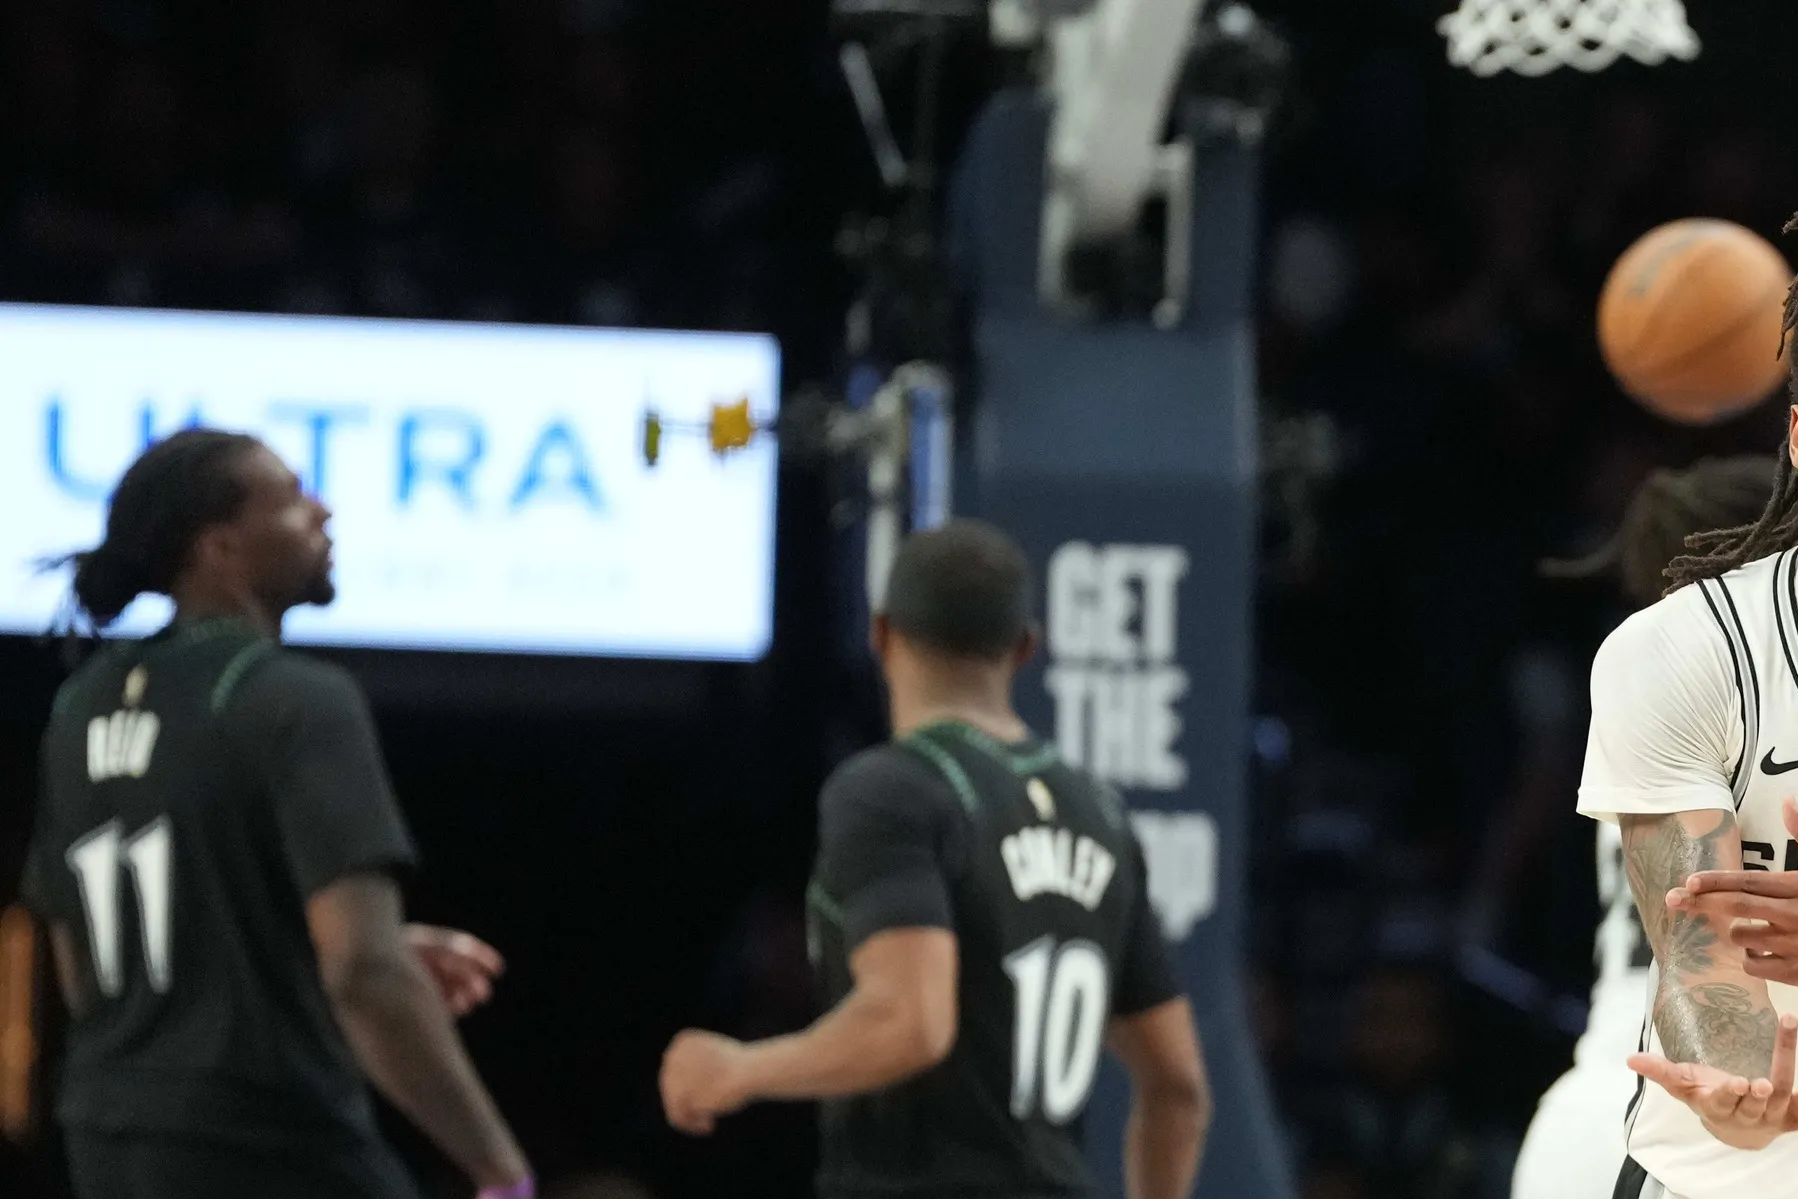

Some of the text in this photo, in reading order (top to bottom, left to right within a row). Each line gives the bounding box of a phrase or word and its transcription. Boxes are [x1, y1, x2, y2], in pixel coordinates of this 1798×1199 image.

[42, 394, 608, 520] UTRA
[1047, 541, 1188, 658] GET
[1044, 663, 1189, 790] THE
[66, 816, 175, 997] 11
[1001, 934, 1107, 1125] 10
